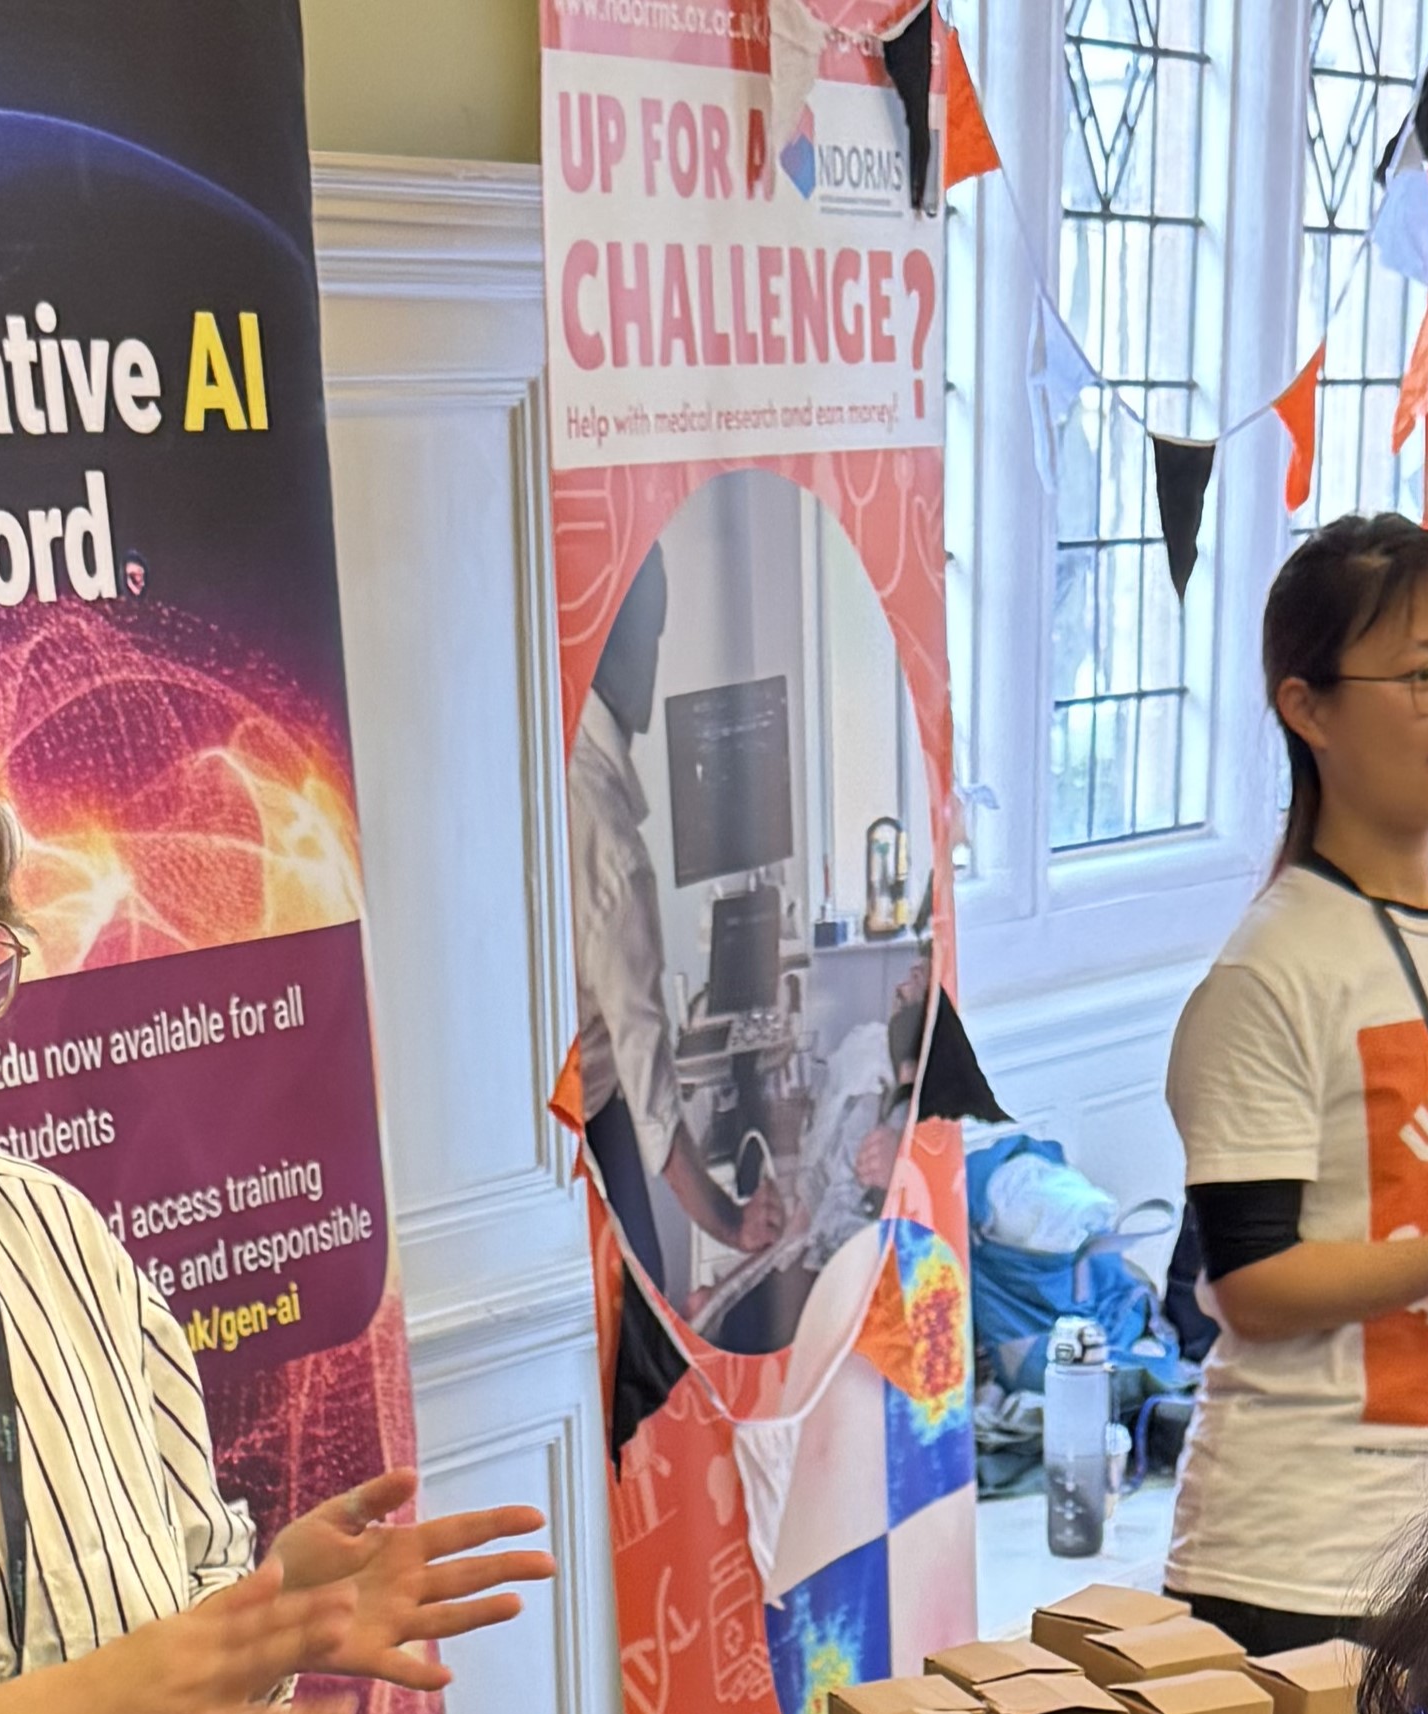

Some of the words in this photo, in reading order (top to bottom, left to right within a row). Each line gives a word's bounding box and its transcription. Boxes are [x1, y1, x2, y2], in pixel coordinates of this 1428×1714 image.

[558, 91, 627, 195] UP
[640, 97, 734, 199] FOR
[746, 108, 776, 200] A
[818, 143, 903, 193] NDORMS
[183, 311, 269, 431] AI
[561, 238, 936, 420] CHALLENGE?
[567, 406, 609, 447] Help
[613, 403, 650, 437] with
[654, 401, 711, 433] medical
[716, 402, 778, 432] research
[781, 401, 812, 428] and
[815, 405, 844, 427] earn
[848, 392, 900, 433] money!
[44, 1035, 103, 1076] now
[110, 1003, 225, 1064] available
[230, 993, 266, 1038] for
[272, 985, 304, 1029] all
[131, 1187, 222, 1240] access
[226, 1160, 323, 1216] training
[147, 1257, 176, 1297] fe
[180, 1240, 228, 1286] and
[232, 1203, 373, 1276] responsible
[183, 1282, 301, 1355] uk/gen-ai
